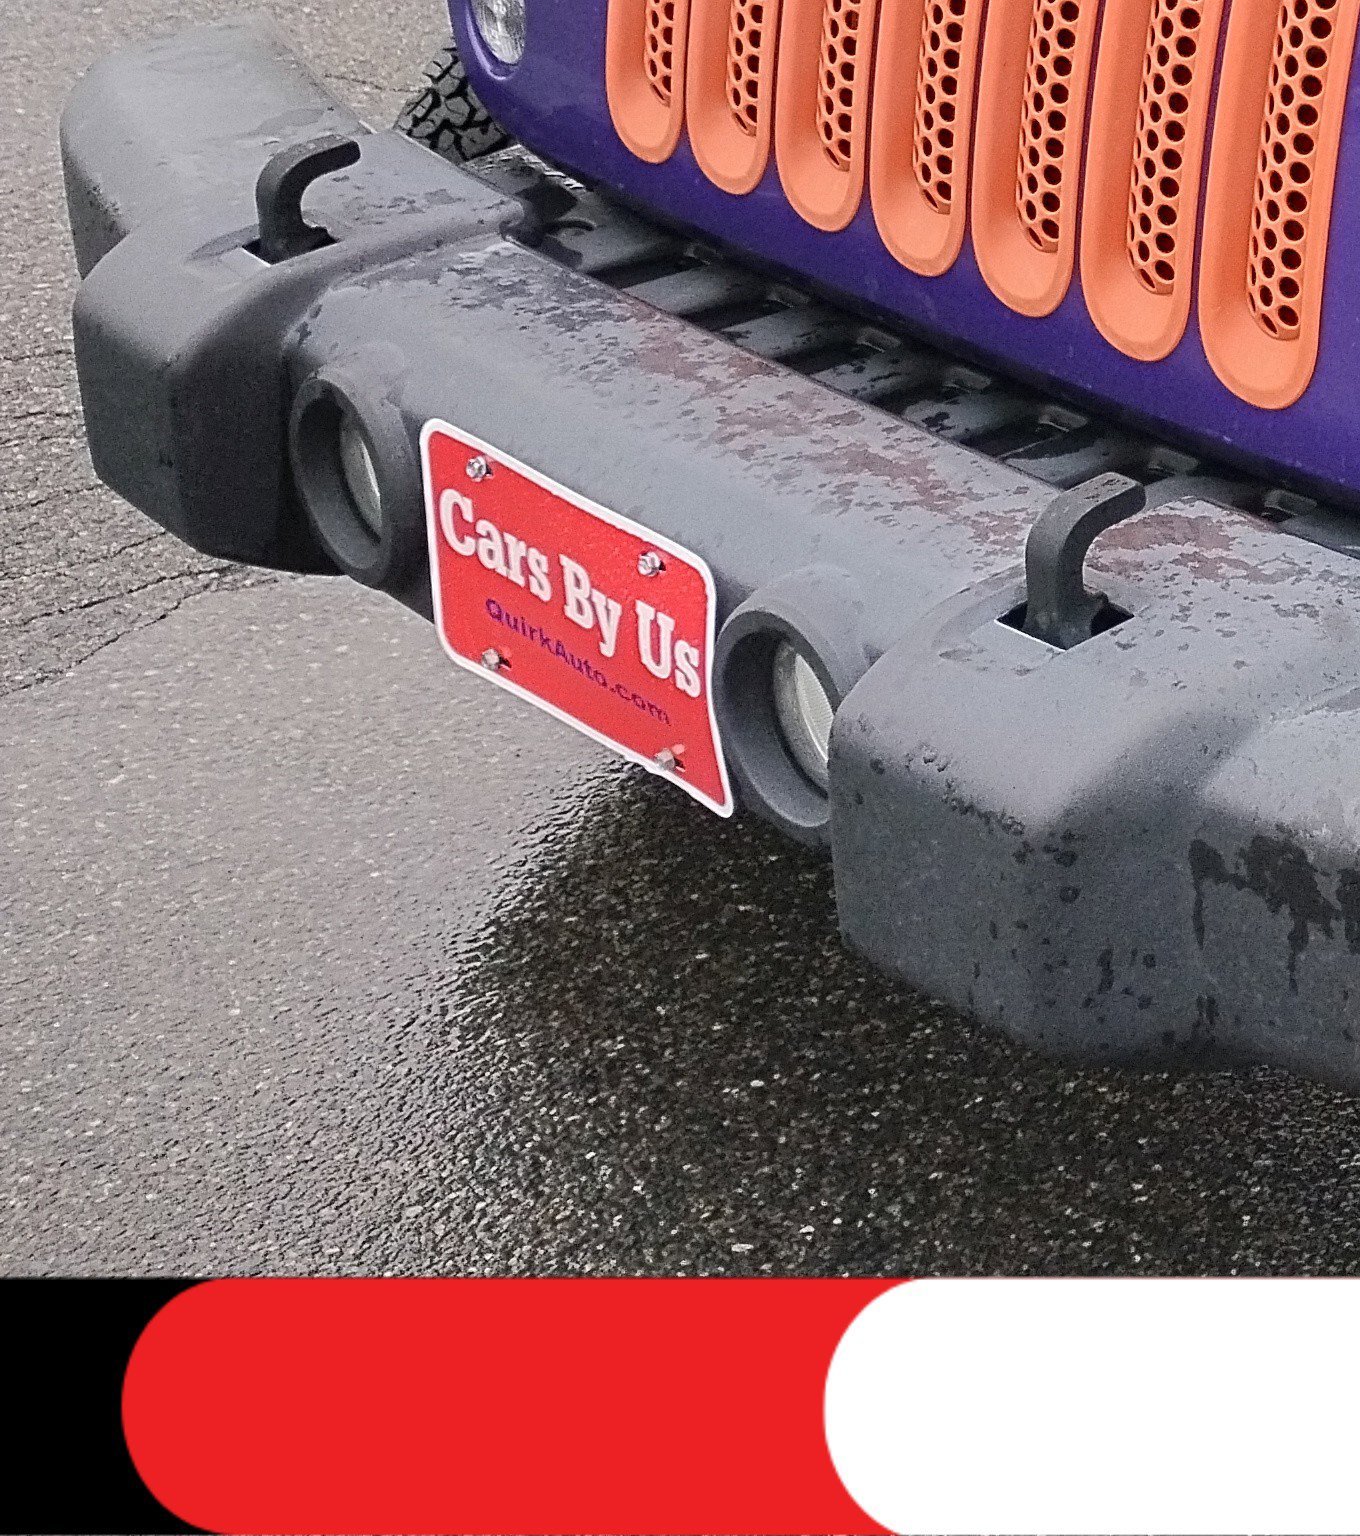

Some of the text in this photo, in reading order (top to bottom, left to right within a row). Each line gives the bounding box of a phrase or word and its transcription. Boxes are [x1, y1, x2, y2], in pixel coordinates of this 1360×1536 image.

[439, 488, 702, 698] Cars By Us
[485, 598, 671, 725] QuirkAuto.com
